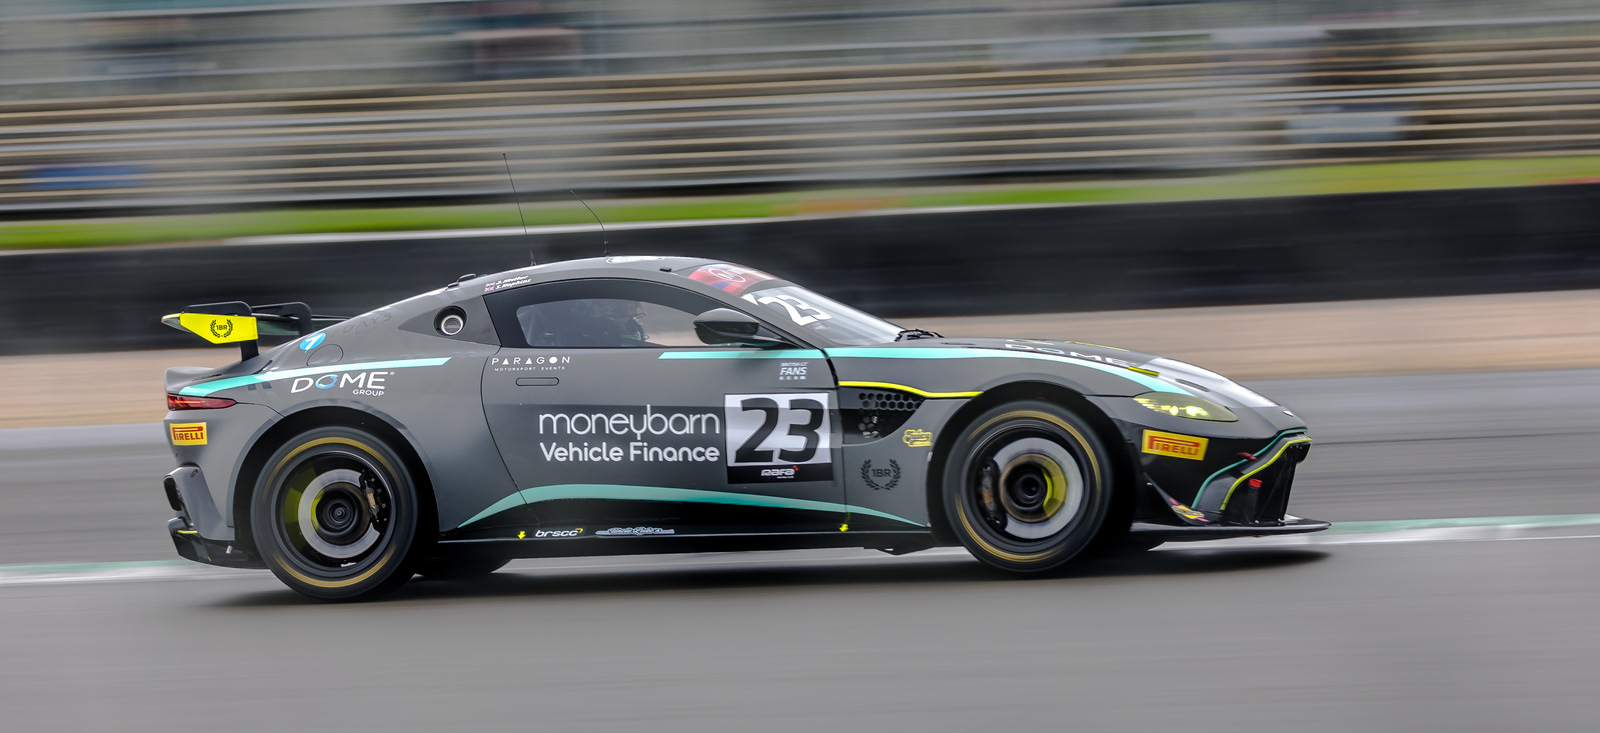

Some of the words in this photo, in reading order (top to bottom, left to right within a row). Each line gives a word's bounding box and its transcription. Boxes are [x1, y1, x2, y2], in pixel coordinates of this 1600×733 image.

[757, 295, 832, 326] 23
[491, 356, 571, 365] PARAGON
[1005, 343, 1130, 366] DOME
[780, 366, 807, 375] FANS
[290, 371, 389, 393] DOME
[352, 388, 385, 397] GROUP
[539, 404, 720, 440] moneybarn
[734, 397, 824, 463] 23
[172, 426, 204, 441] PIRELLI
[539, 441, 624, 462] Vehicle
[630, 441, 720, 462] Finance
[1148, 435, 1201, 456] PIRELLI
[871, 468, 892, 477] 1BR
